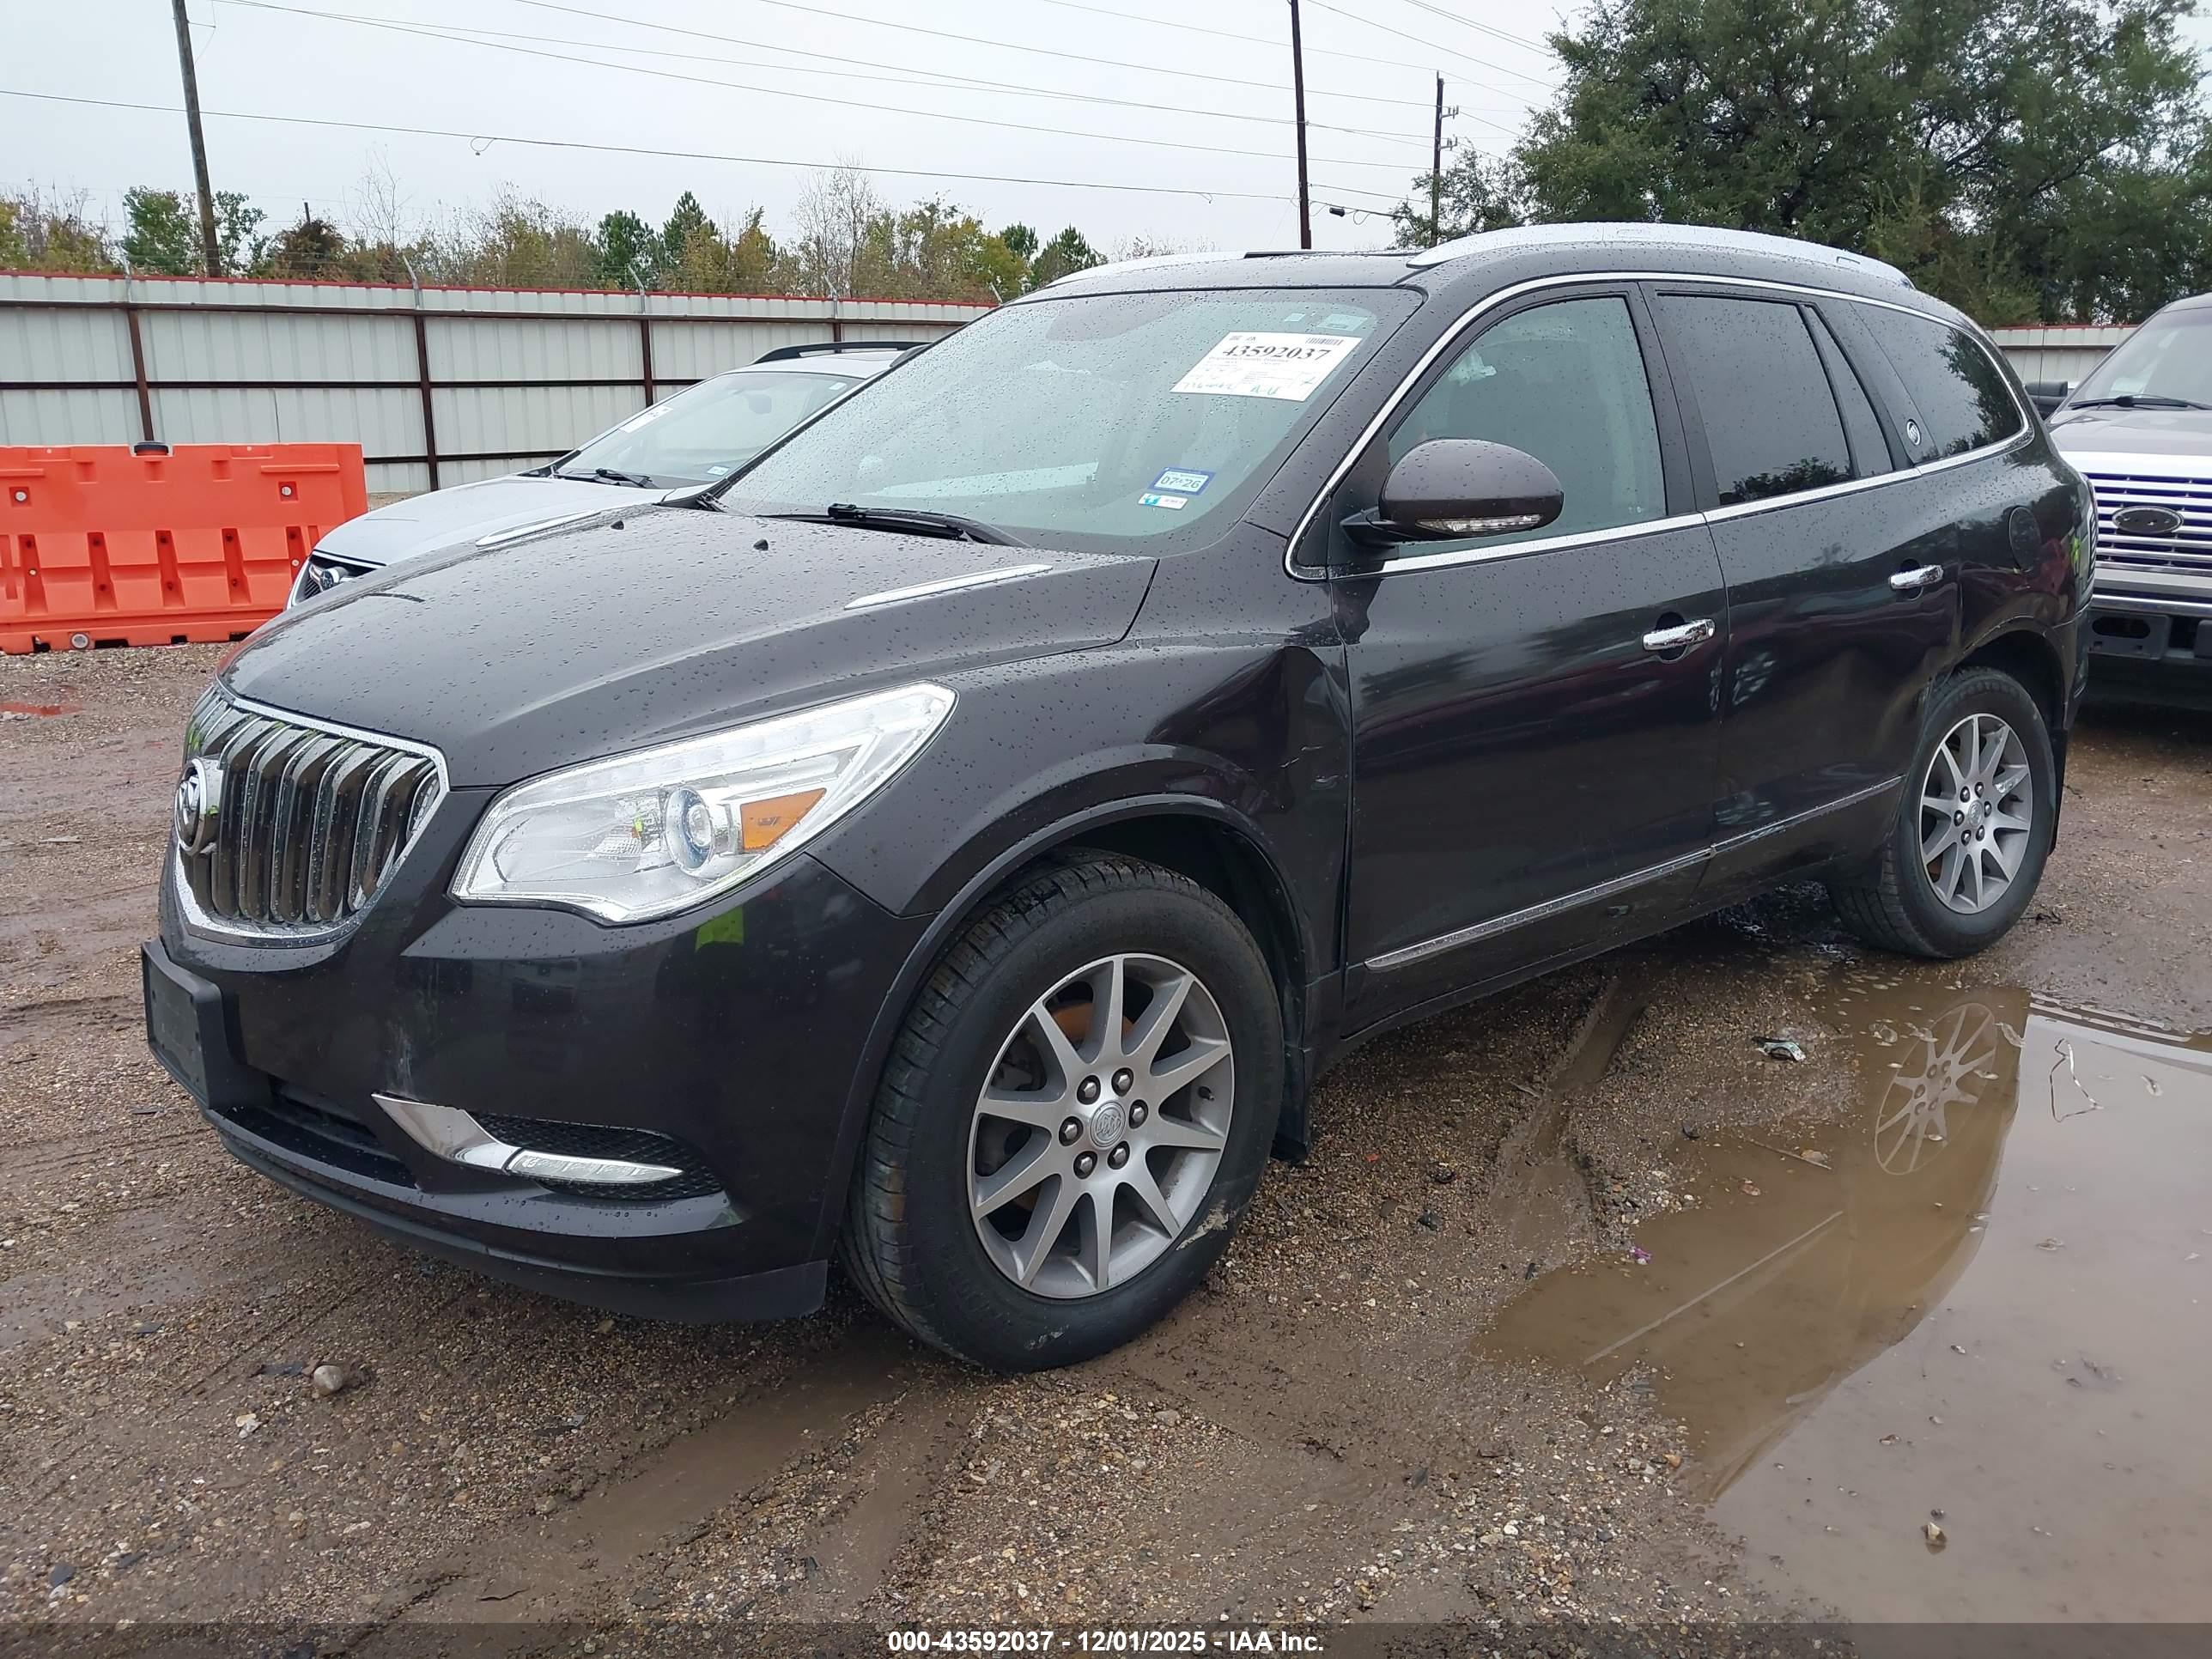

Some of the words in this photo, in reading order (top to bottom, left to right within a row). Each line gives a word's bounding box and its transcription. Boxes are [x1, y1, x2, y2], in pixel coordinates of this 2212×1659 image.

[1222, 344, 1332, 361] 43592037
[1159, 475, 1178, 485] 07
[1182, 478, 1202, 489] 26
